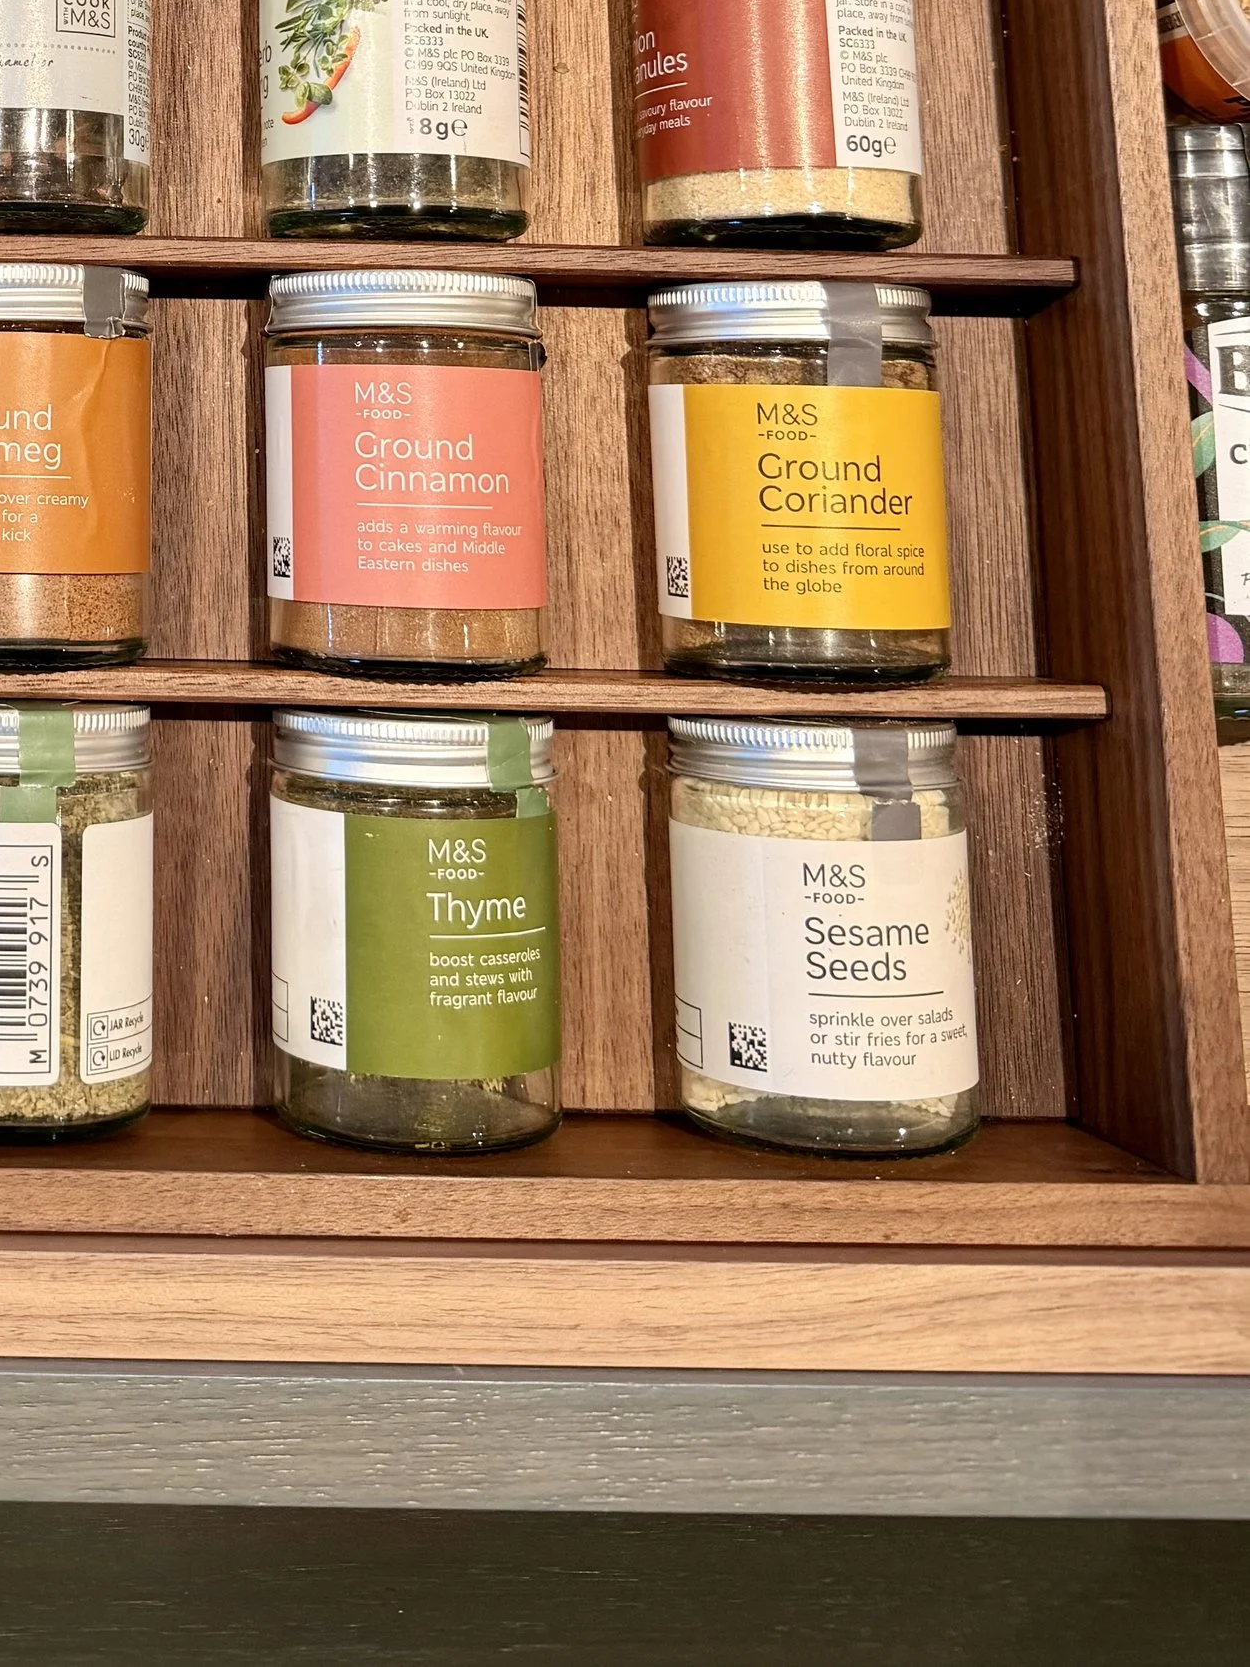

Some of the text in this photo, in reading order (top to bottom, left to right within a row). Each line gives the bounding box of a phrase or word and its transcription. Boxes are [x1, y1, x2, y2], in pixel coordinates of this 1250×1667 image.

[70, 9, 111, 30] M&S
[838, 26, 873, 36] Packed
[839, 38, 875, 49] SC6333
[425, 89, 475, 101] Box 13022
[670, 95, 712, 109] flavour
[660, 115, 690, 130] meals
[355, 382, 412, 404] M&S
[757, 403, 818, 425] M&S
[355, 432, 473, 460] Ground
[355, 463, 509, 494] Cinnamon
[758, 452, 880, 482] Ground
[759, 485, 912, 515] Coriander
[358, 556, 468, 572] Eastern dishes
[428, 838, 487, 864] M&S
[802, 862, 866, 888] M&S
[30, 897, 49, 945] 917
[426, 892, 526, 929] Thyme
[804, 916, 929, 946] Sesame
[806, 951, 907, 981] Seeds
[28, 961, 48, 1026] 0739
[811, 1051, 916, 1069] nutty flavour
